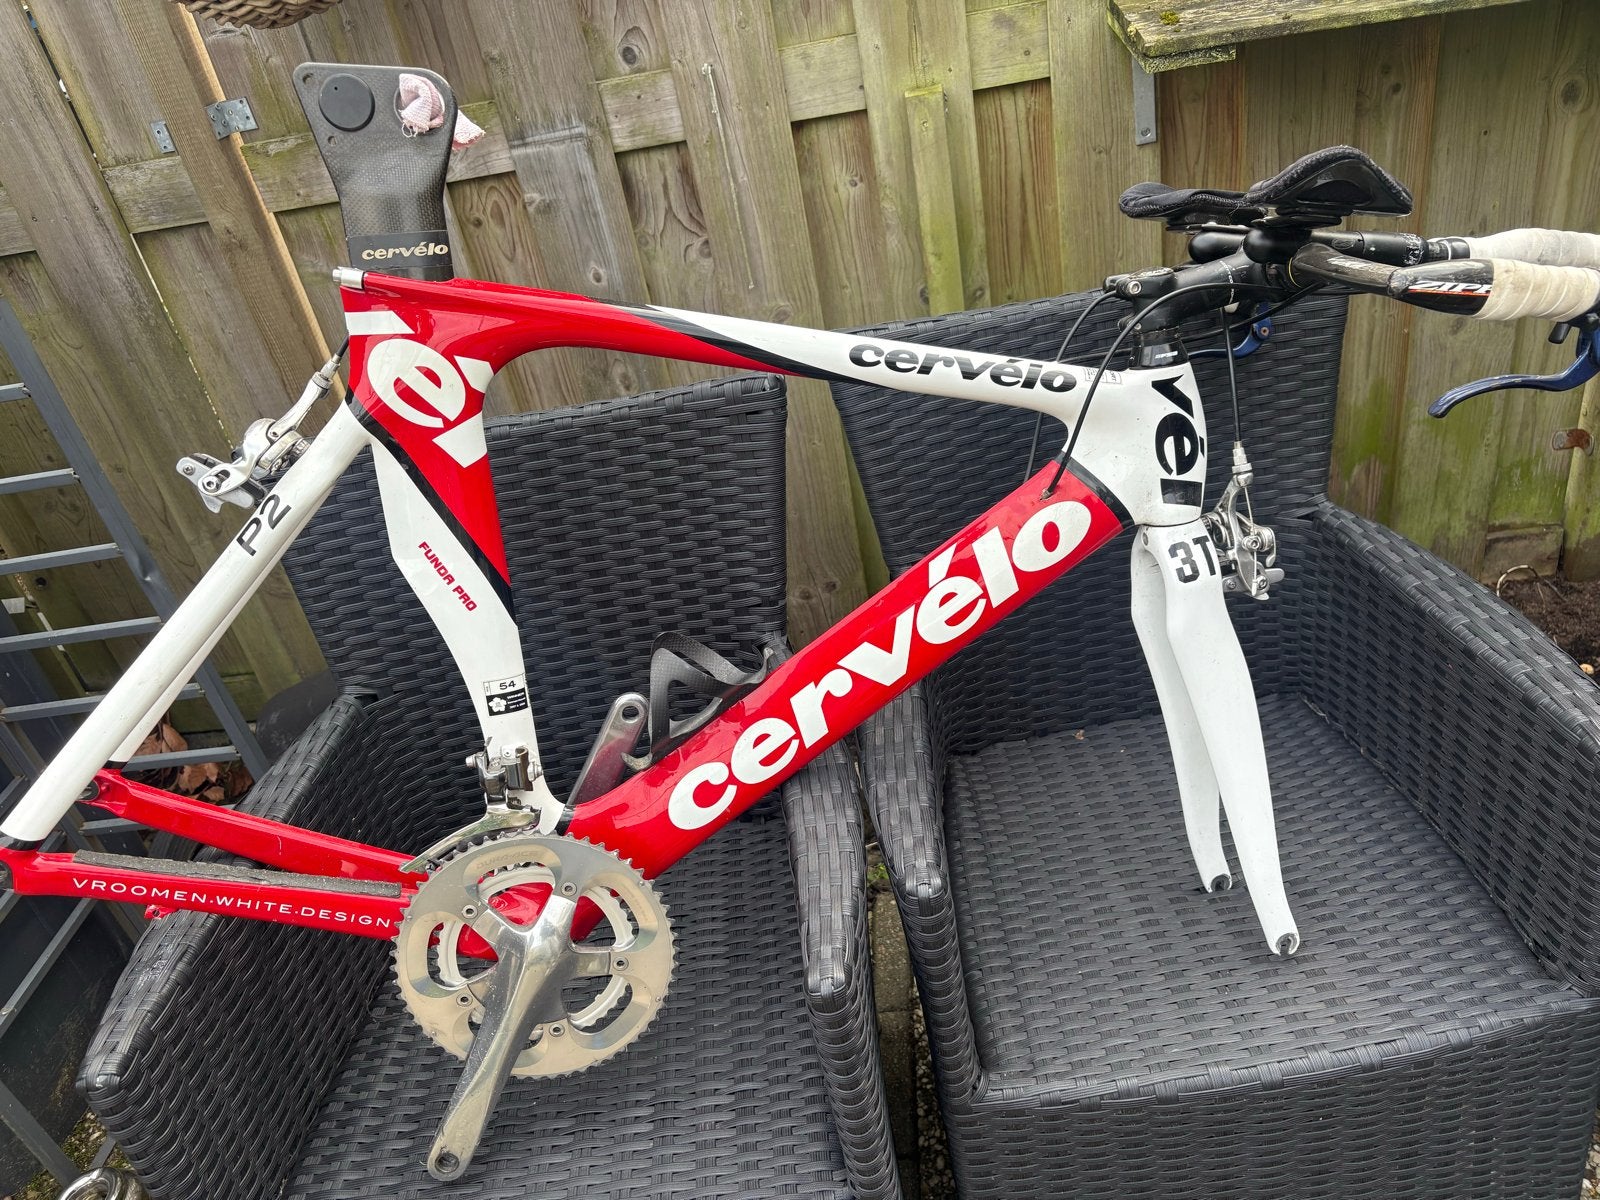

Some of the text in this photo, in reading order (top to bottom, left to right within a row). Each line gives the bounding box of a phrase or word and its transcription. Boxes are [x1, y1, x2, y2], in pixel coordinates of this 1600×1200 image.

[361, 241, 449, 260] cervélo
[848, 343, 1077, 393] cervélo
[236, 493, 292, 557] P2
[418, 541, 478, 612] FUNDA PRO
[1168, 535, 1217, 584] 3T
[499, 680, 516, 691] 54
[667, 500, 1092, 831] cervélo
